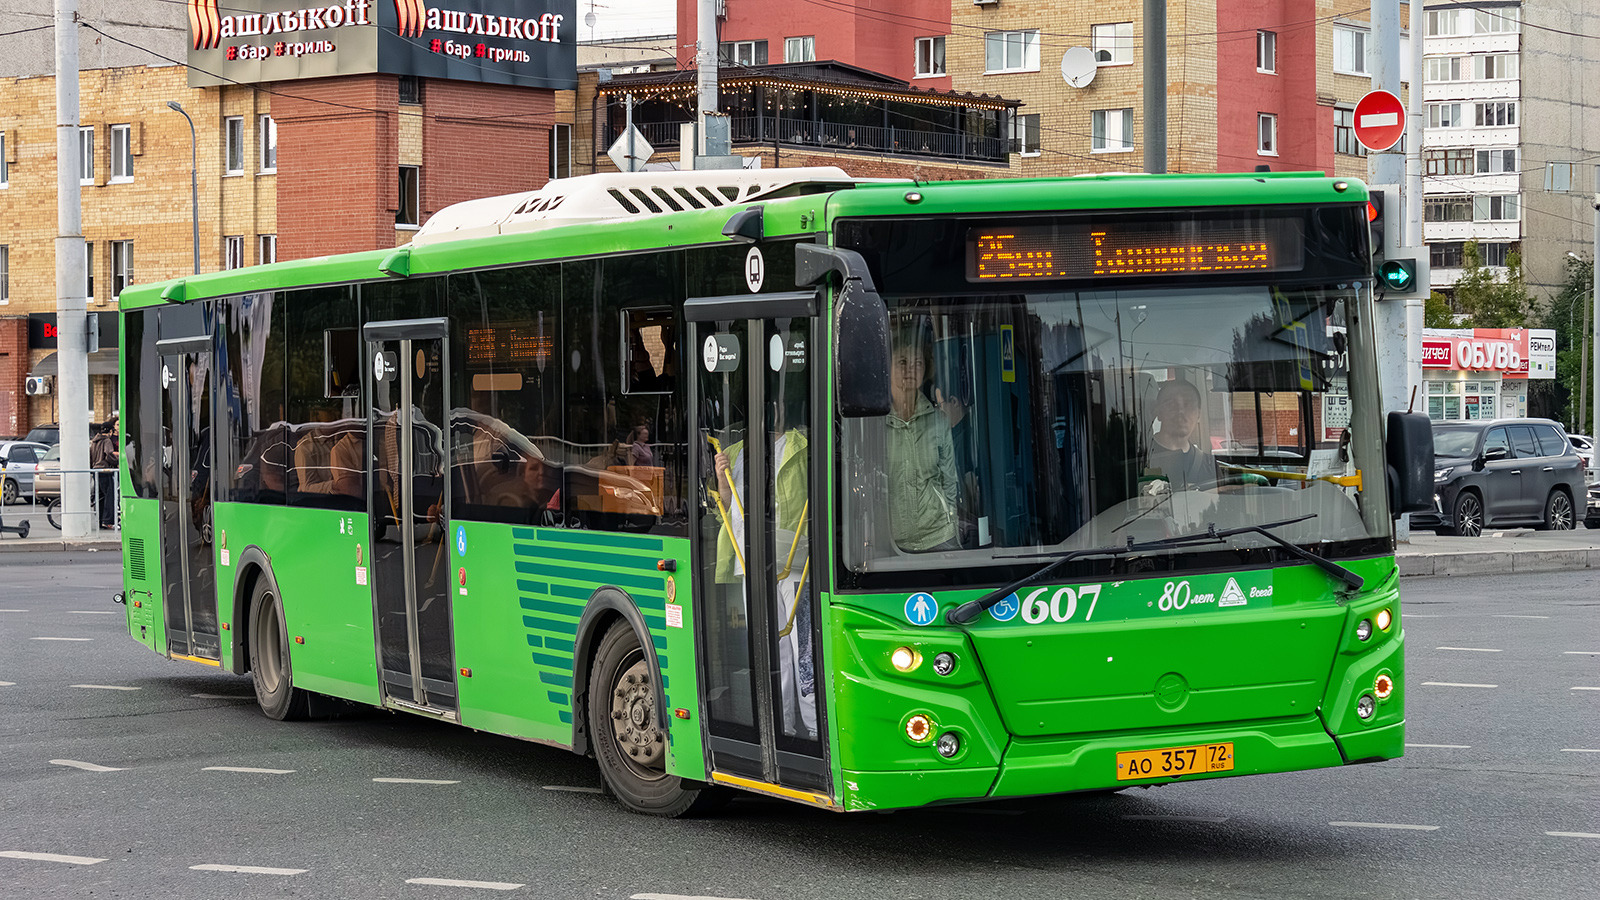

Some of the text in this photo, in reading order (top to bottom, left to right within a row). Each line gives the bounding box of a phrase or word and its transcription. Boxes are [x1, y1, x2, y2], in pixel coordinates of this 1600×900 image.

[1457, 340, 1520, 369] ОБУВЬ
[1501, 381, 1522, 391] ЕМОНТ
[1021, 584, 1102, 624] 607
[1158, 580, 1190, 611] 80
[1190, 593, 1215, 605] лет
[1161, 749, 1197, 772] 357
[1208, 746, 1227, 762] 72
